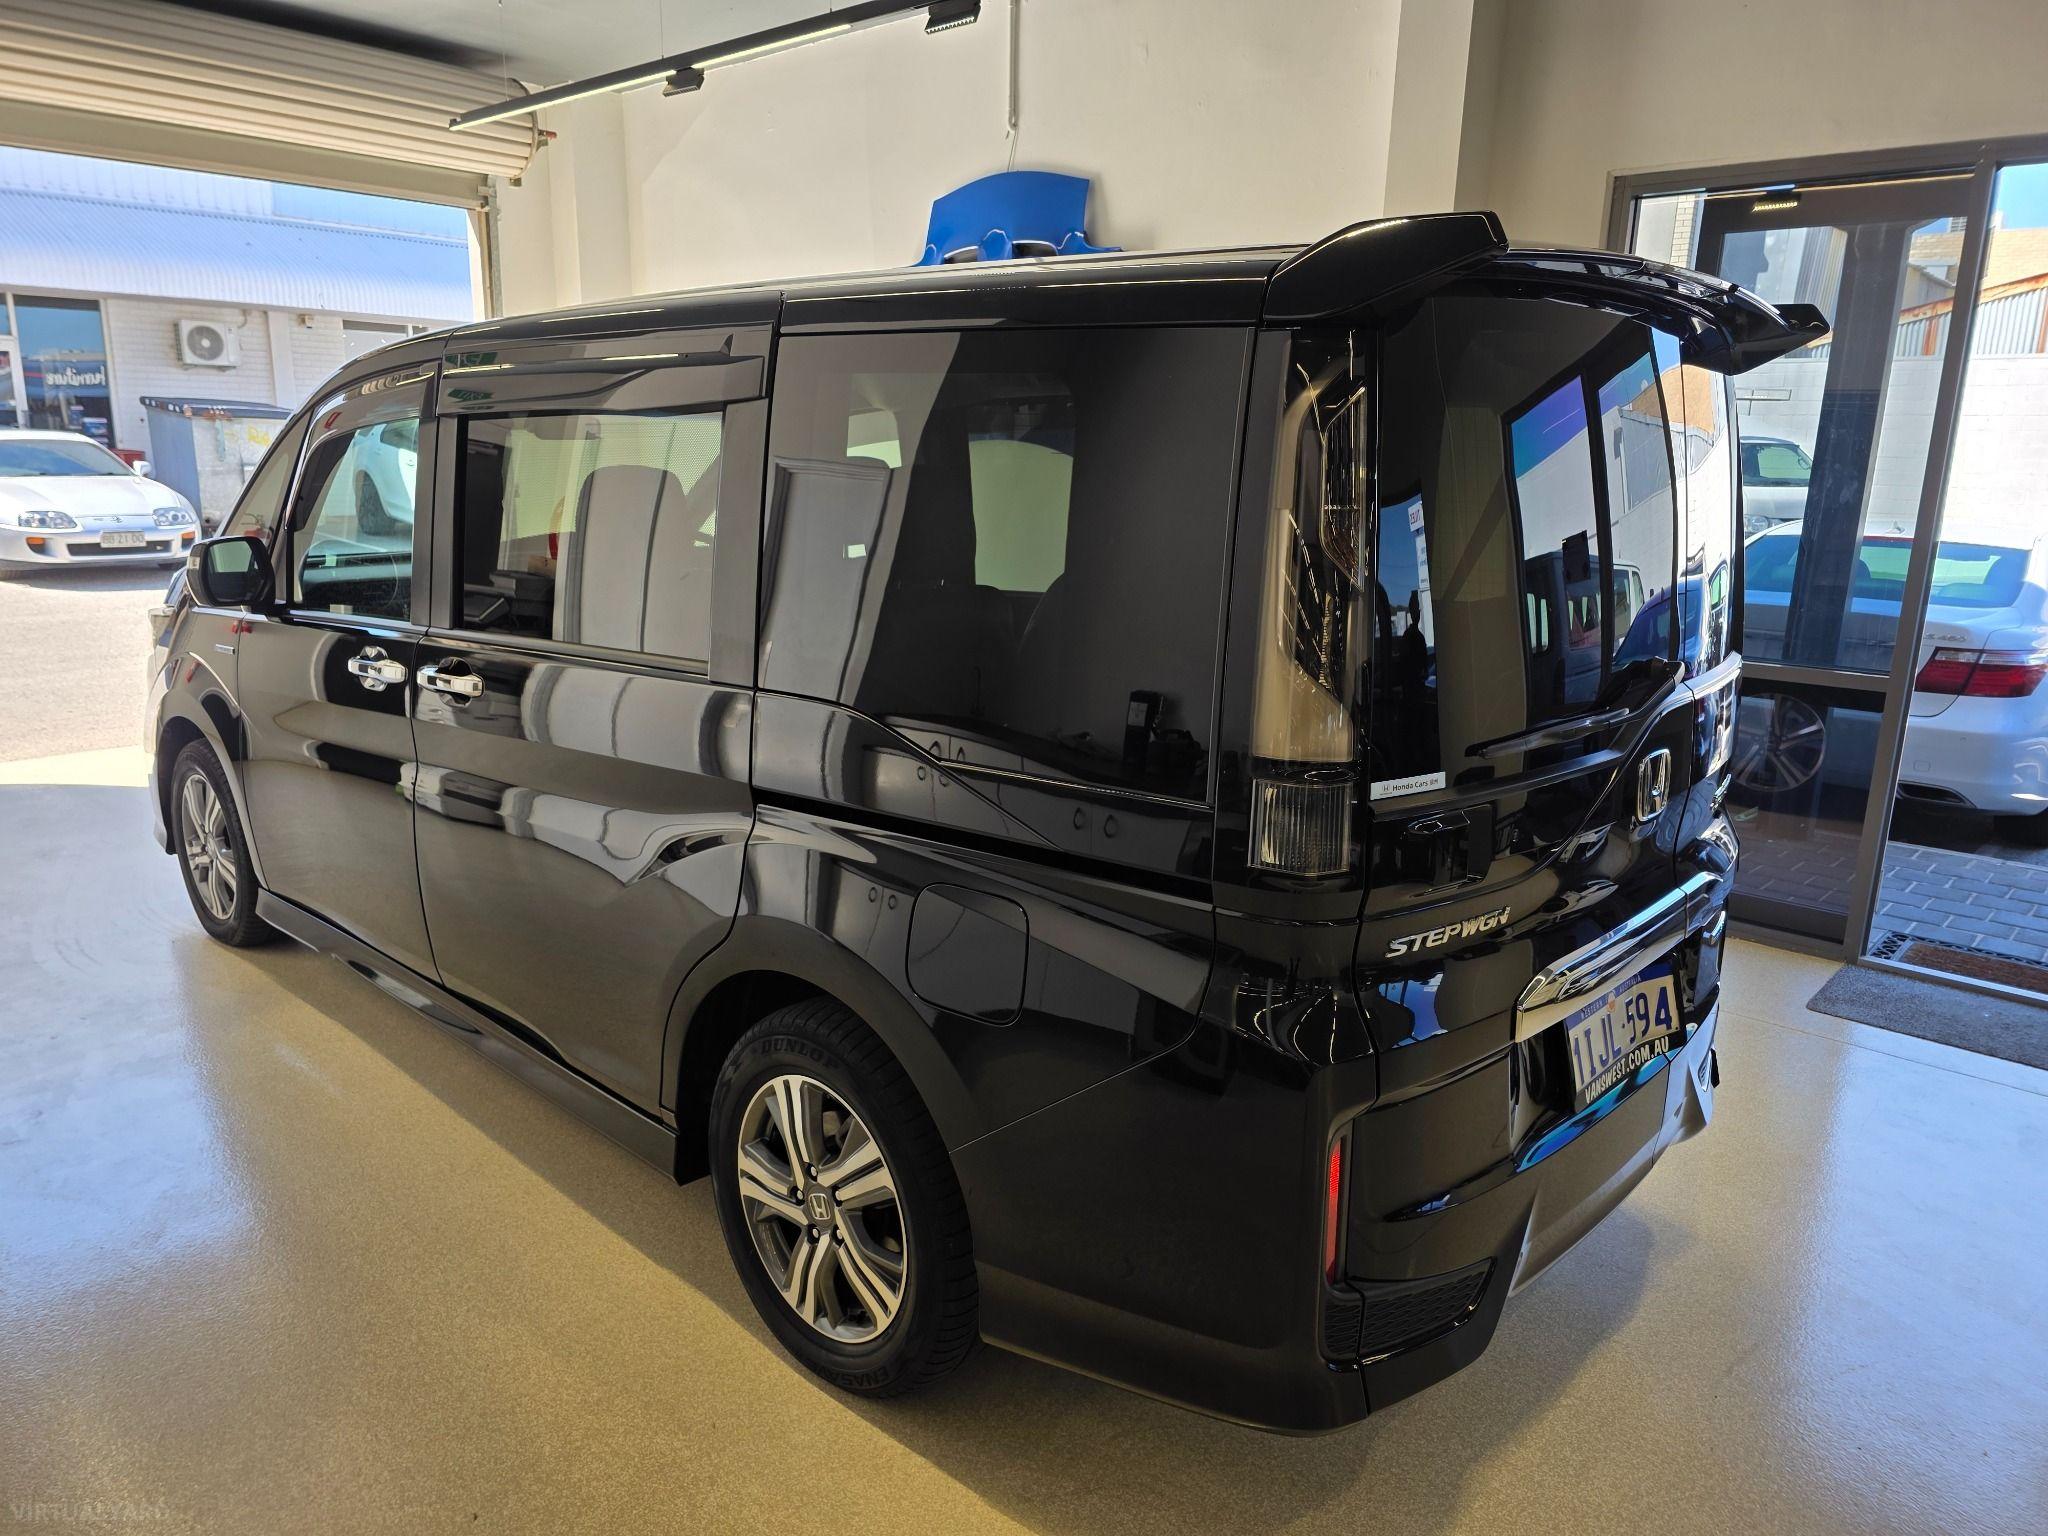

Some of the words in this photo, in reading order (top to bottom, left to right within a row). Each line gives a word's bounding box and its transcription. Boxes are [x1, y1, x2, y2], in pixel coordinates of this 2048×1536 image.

[1393, 782, 1413, 791] Honda
[1385, 905, 1511, 958] STEPWGN
[1618, 973, 1642, 994] AUSTRALIA
[761, 1037, 838, 1069] DUNLOP
[1585, 1036, 1669, 1104] VANSWEST.COM.AU
